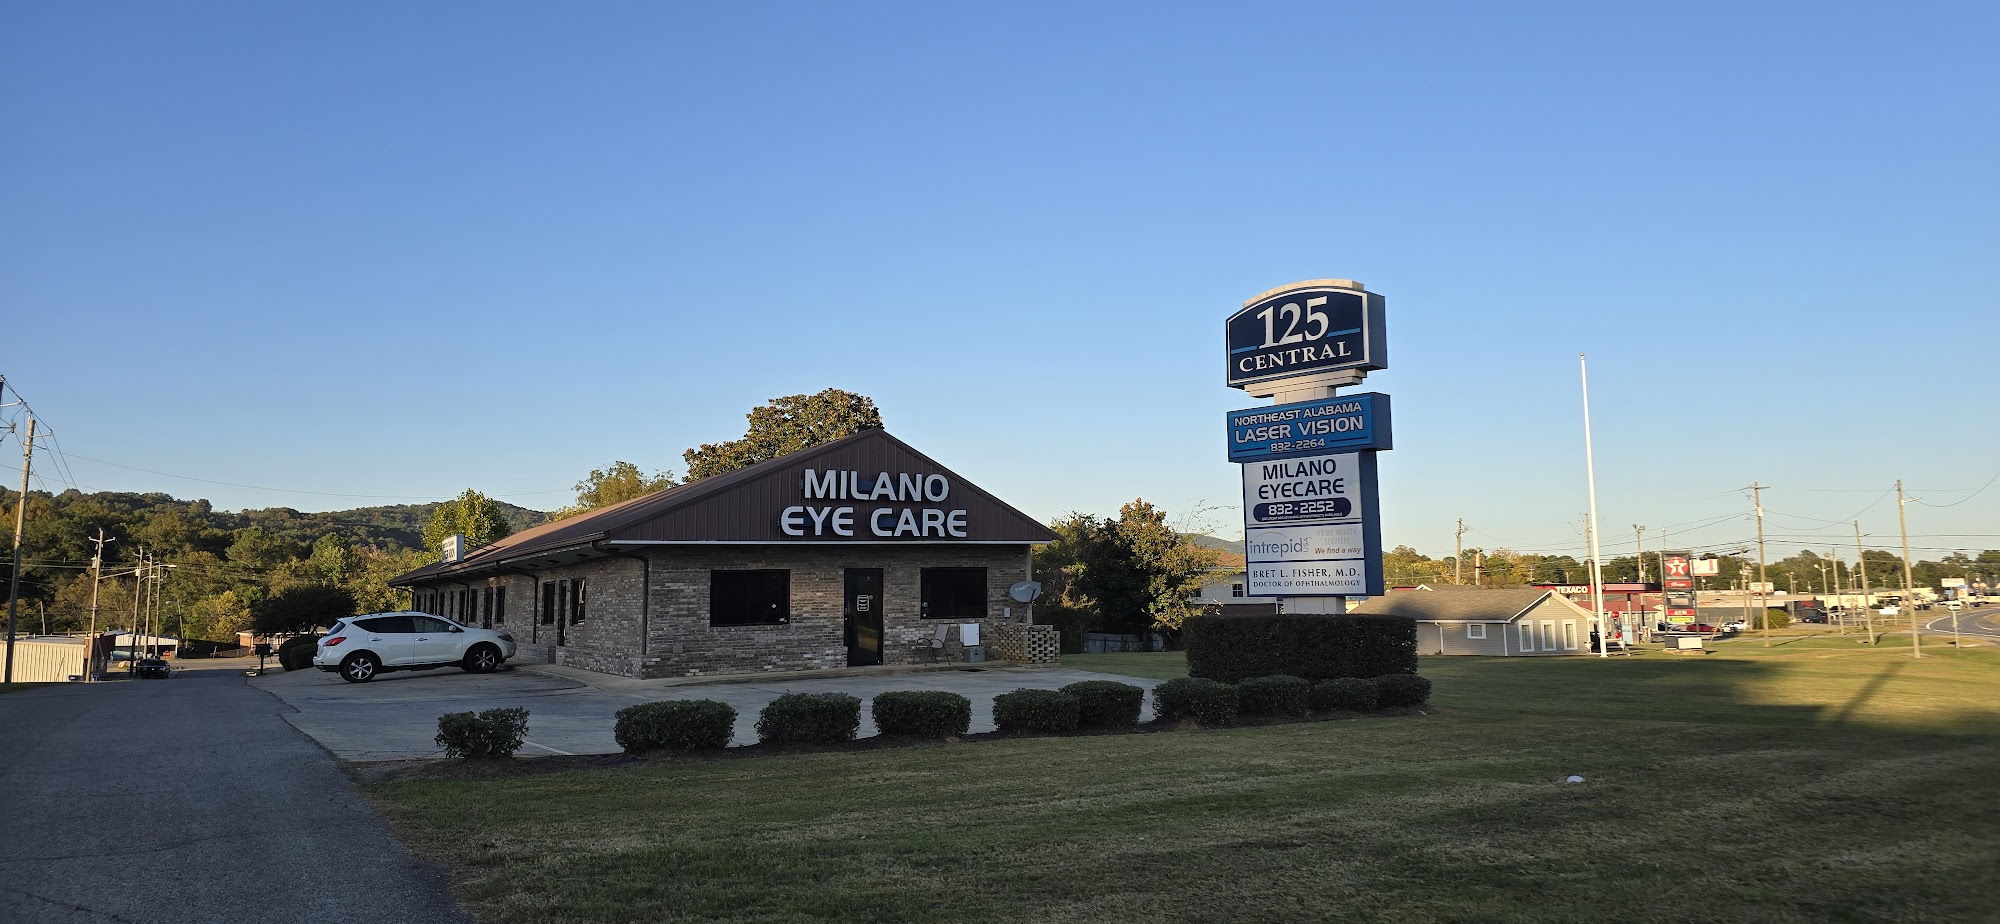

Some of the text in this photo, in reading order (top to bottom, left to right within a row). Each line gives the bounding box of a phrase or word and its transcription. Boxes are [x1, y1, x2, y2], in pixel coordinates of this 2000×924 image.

[1256, 296, 1330, 349] 125
[1239, 341, 1351, 372] CENTRAL
[1234, 402, 1362, 427] NORTHEAST ALABAMA
[1235, 415, 1364, 443] LASER VISION
[1270, 438, 1326, 452] 832-2264
[1262, 458, 1337, 481] MILANO
[804, 468, 950, 502] MILANO
[1258, 477, 1345, 500] EYECARE
[1268, 500, 1335, 516] 832-2252
[780, 506, 967, 537] EYE CARE
[1249, 537, 1303, 557] intrepid
[1347, 547, 1362, 555] way
[1253, 567, 1361, 578] BRET L. FISHER, M.D.
[1295, 579, 1361, 587] OPHTHALMOLOGY
[1556, 585, 1589, 594] TEXACO
